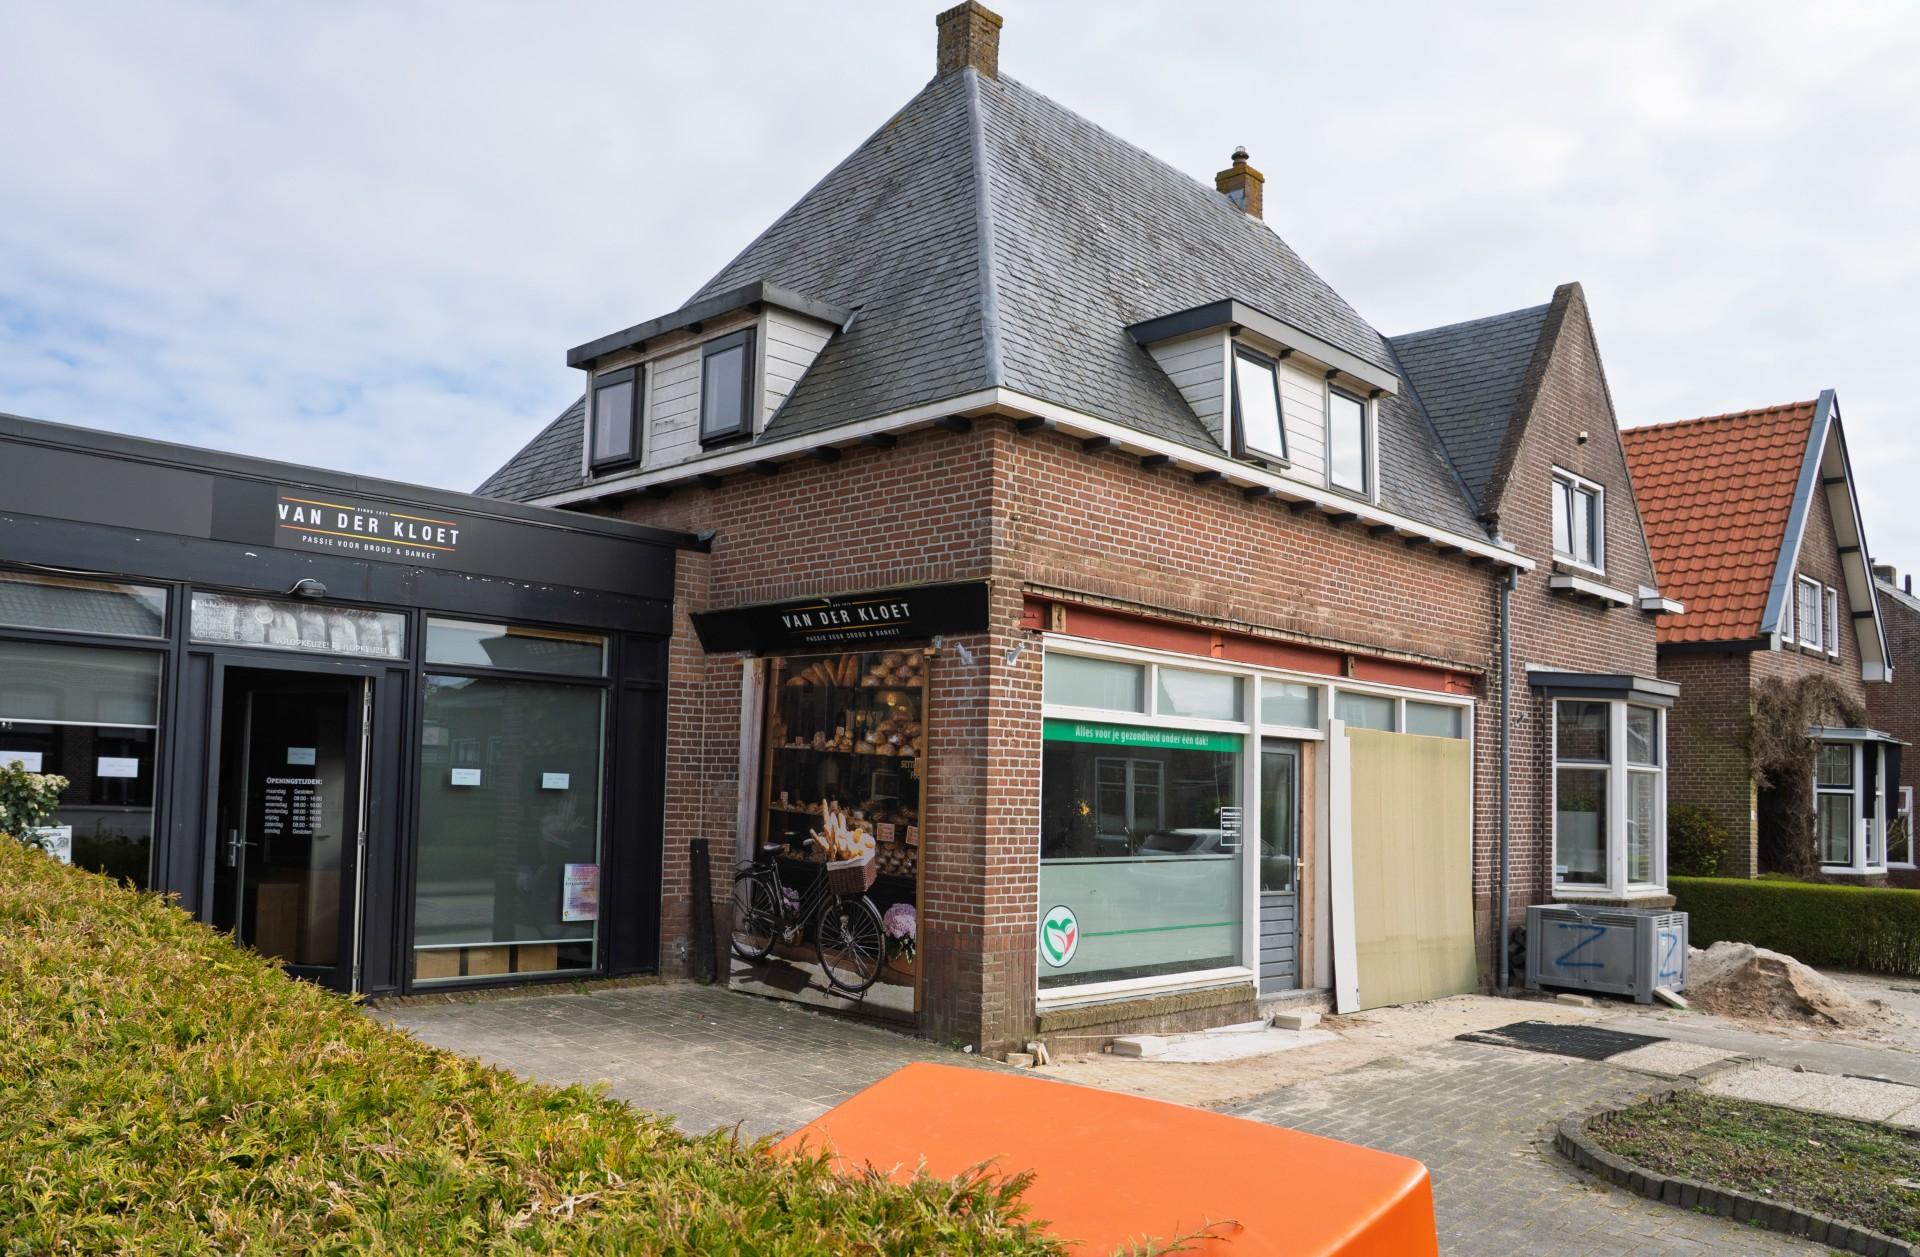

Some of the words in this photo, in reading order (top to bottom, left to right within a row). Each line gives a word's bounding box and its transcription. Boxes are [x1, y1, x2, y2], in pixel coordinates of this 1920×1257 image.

[278, 504, 322, 525] VAN
[337, 513, 378, 533] DER
[394, 521, 460, 545] KLOET
[302, 535, 333, 546] PASSIE
[337, 540, 360, 550] VOOR
[364, 543, 392, 554] BROOD
[405, 550, 436, 560] BANKET
[782, 613, 813, 628] VAN
[820, 610, 851, 625] DER
[858, 603, 910, 621] KLOET
[875, 628, 900, 636] BANKET
[1075, 725, 1094, 738] Alles
[1096, 729, 1111, 739] voor
[1112, 730, 1120, 743] je
[1121, 731, 1160, 743] gezondheid
[1161, 733, 1181, 744] onder
[1194, 735, 1209, 746] dak!
[1555, 923, 1608, 969] Z
